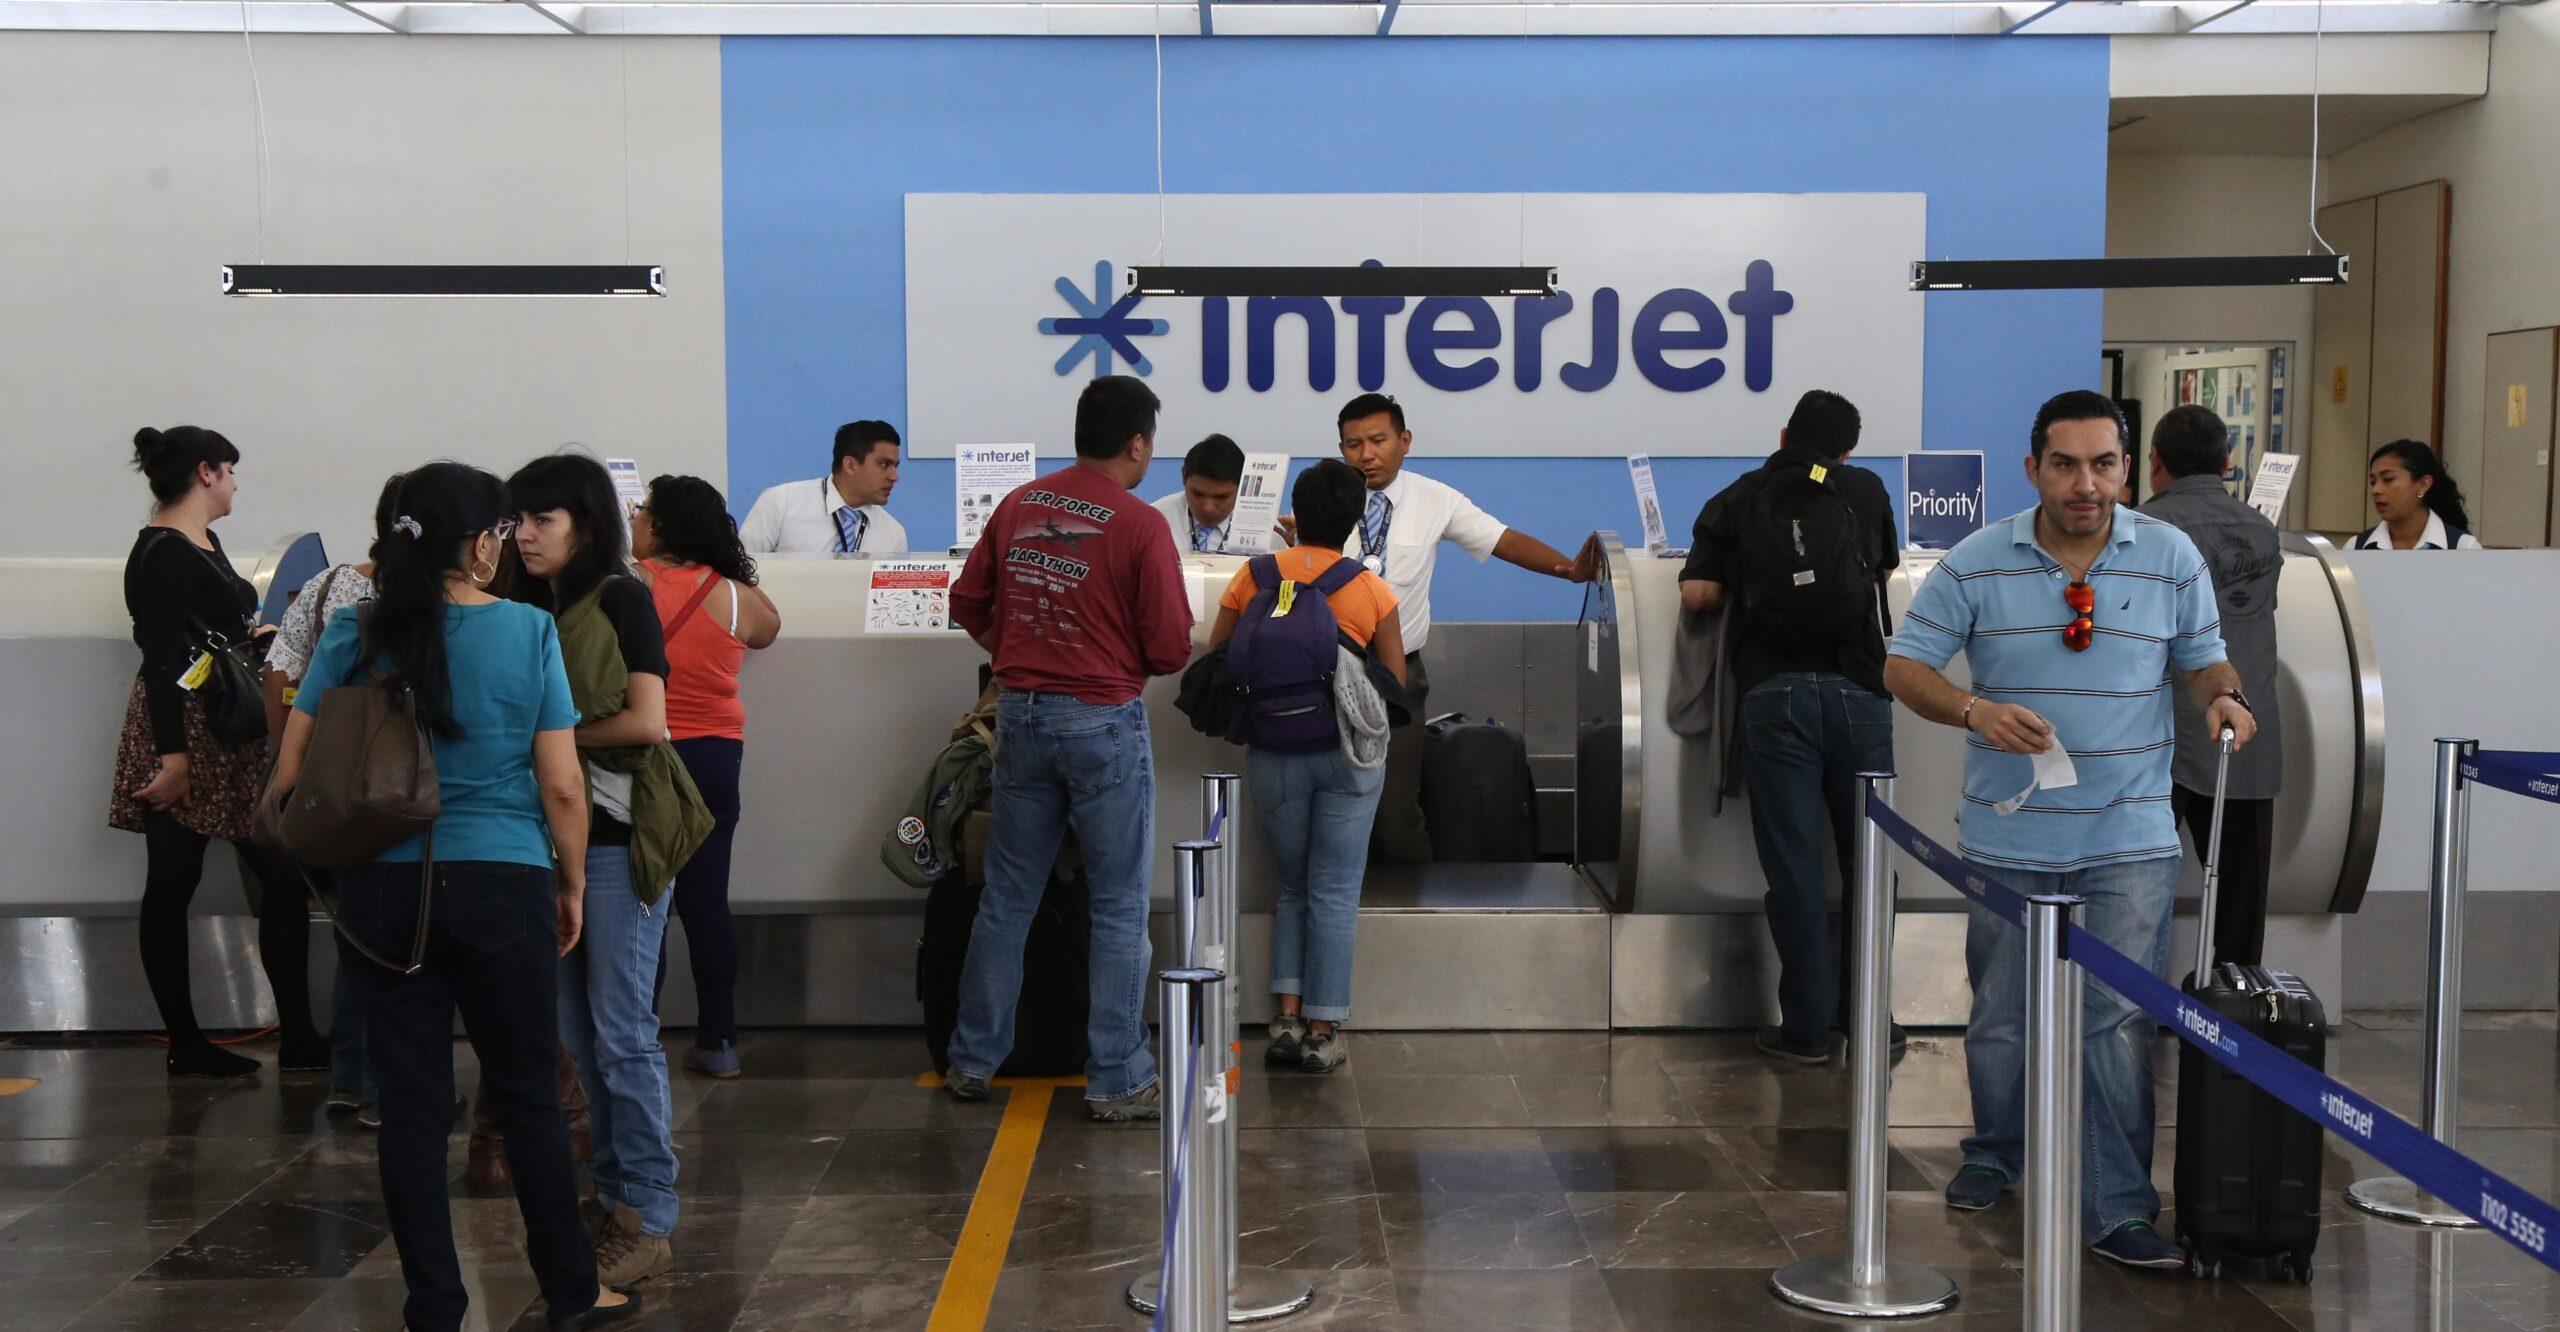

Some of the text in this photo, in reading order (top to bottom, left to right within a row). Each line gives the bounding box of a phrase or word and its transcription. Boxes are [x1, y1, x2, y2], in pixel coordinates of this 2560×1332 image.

[1202, 259, 1793, 393] interjet
[977, 450, 1031, 462] interjet
[1256, 462, 1278, 471] interjet
[2267, 460, 2293, 474] interjet
[1020, 490, 1116, 523] AIR FORCE
[1909, 485, 1981, 523] Priority
[893, 563, 948, 571] interjet
[1005, 547, 1090, 580] MARATHON
[2531, 779, 2559, 797] interjet
[2184, 1008, 2239, 1058] interjet.com
[2327, 1093, 2375, 1140] interjet
[2481, 1191, 2547, 1253] 1102 5555
